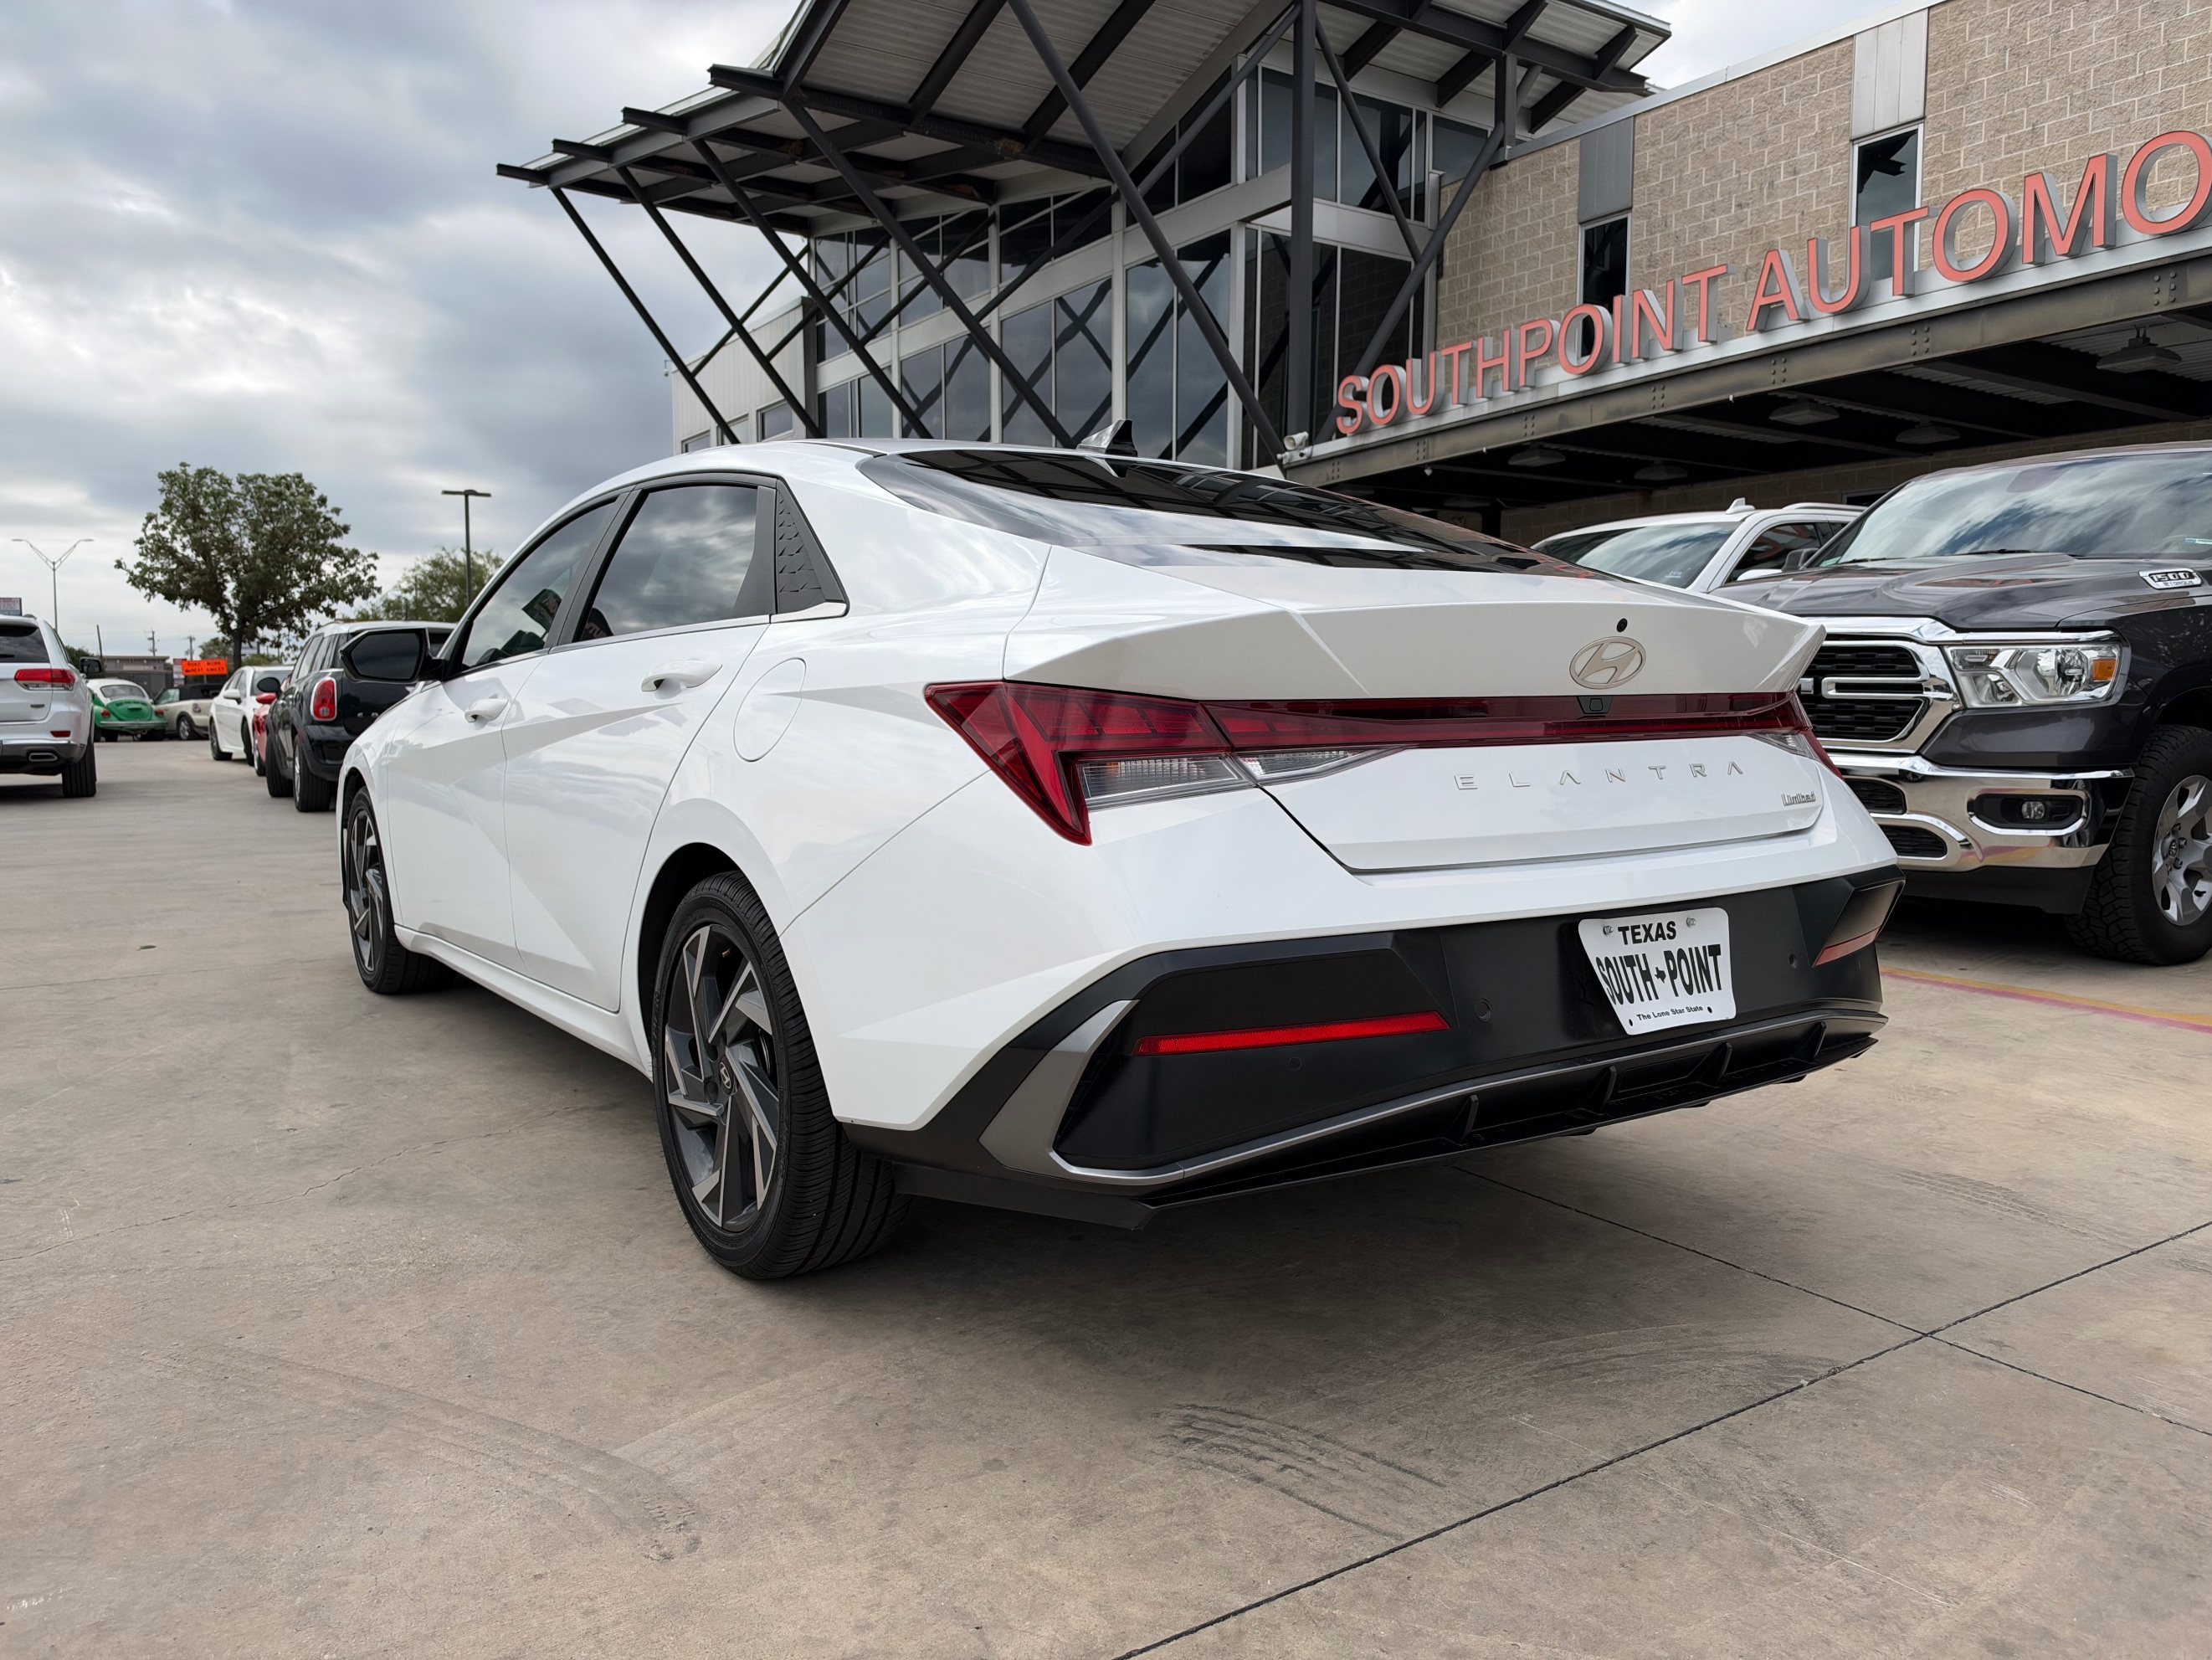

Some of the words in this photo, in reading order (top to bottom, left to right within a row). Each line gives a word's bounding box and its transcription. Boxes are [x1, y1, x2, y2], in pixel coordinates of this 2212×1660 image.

[1337, 264, 1729, 434] SOUTHPOINT
[1746, 130, 2212, 331] AUTOMO
[2151, 572, 2189, 582] 1500
[1454, 761, 1744, 790] ELANTRA
[1618, 921, 1677, 945] TEXAS
[1595, 953, 1660, 1005] SOUTH
[1663, 943, 1722, 997] POINT
